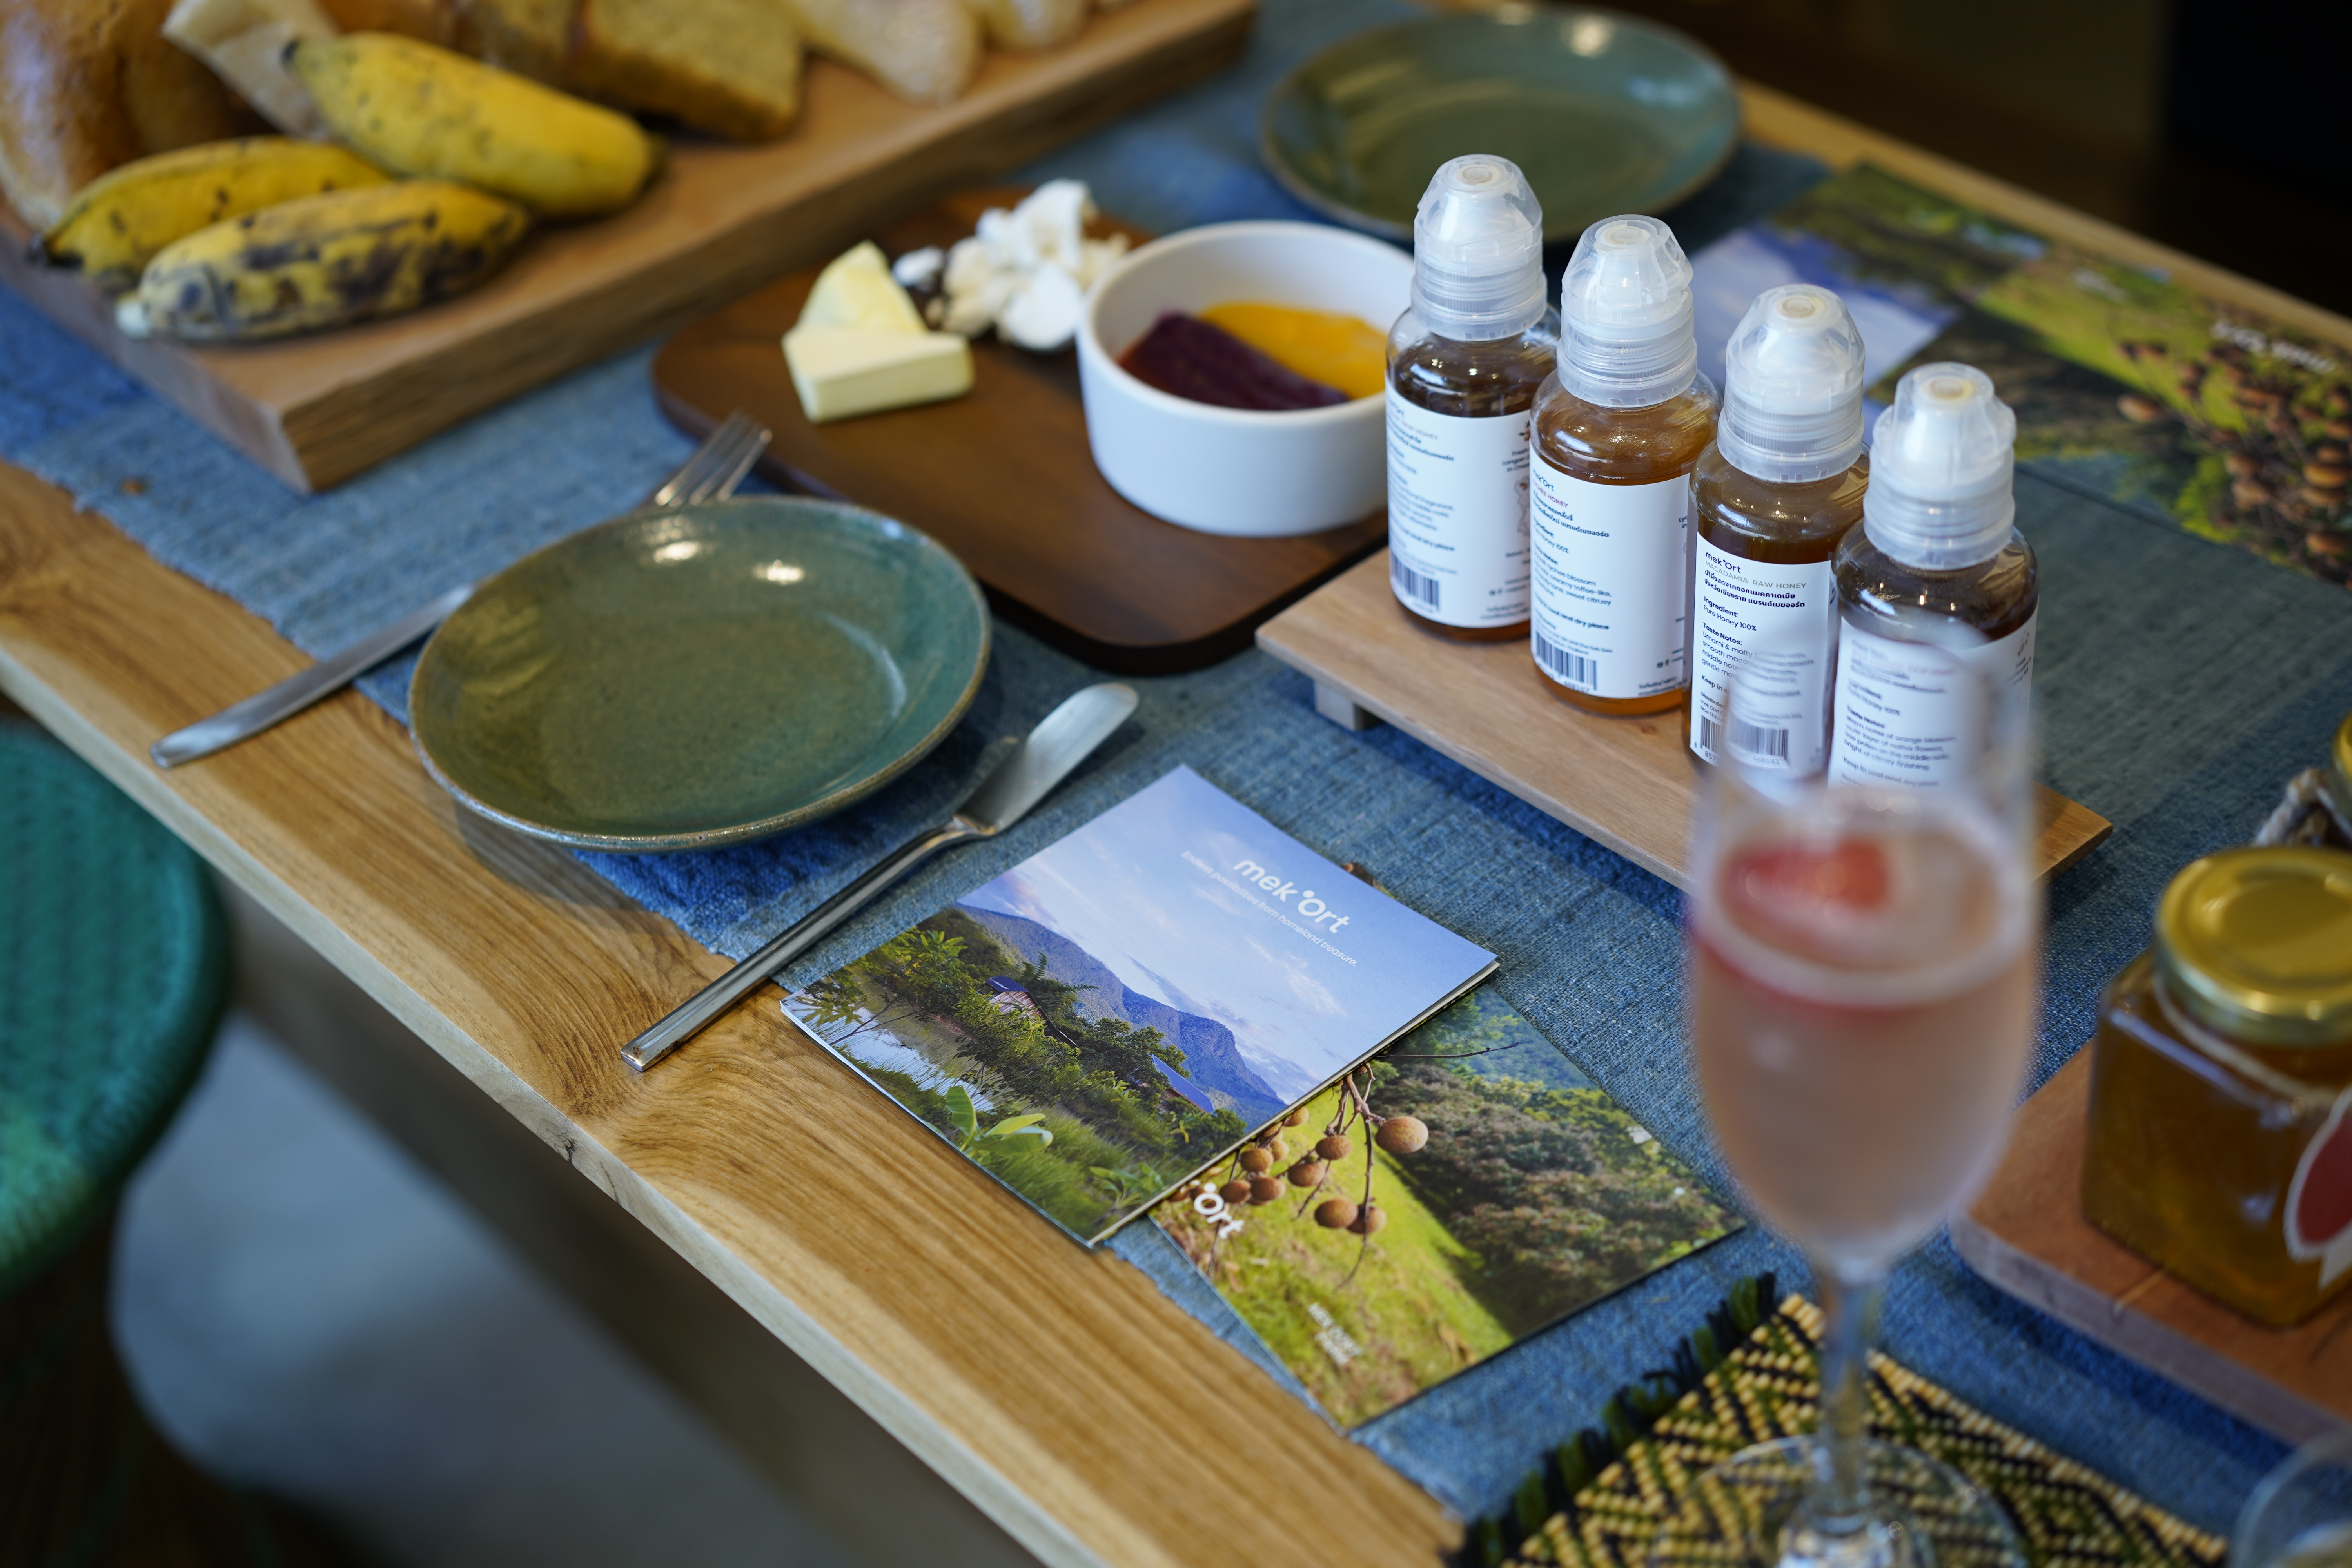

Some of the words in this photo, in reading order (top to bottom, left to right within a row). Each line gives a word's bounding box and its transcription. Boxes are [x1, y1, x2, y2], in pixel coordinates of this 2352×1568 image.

[1547, 494, 1568, 508] HONEY
[1556, 543, 1569, 554] 100%
[1548, 564, 1566, 577] lychee
[1567, 573, 1596, 586] blossom
[1705, 560, 1748, 584] MACADAMIA
[1753, 579, 1773, 588] RAW
[1550, 575, 1572, 590] creamy
[1565, 590, 1585, 601] sweet
[1586, 597, 1611, 606] citrusy
[1560, 613, 1573, 622] and
[1574, 619, 1586, 628] dry
[1704, 605, 1716, 617] Pure
[1717, 613, 1739, 628] Honey
[1740, 622, 1757, 632] 100%
[1703, 622, 1719, 636] Taste
[1720, 633, 1742, 646] Notes:
[1702, 641, 1725, 657] smooth
[1703, 631, 1724, 648] Umami
[1731, 647, 1753, 659] malty
[1702, 649, 1722, 664] middle
[1702, 658, 1720, 672] gentle
[1702, 674, 1716, 688] Keep
[1844, 738, 1862, 753] bright
[1843, 756, 1859, 770] Keep
[1885, 774, 1902, 783] and
[1209, 872, 1259, 905] possibilities
[1257, 902, 1279, 918] from
[1278, 915, 1324, 944] homeland
[1320, 942, 1357, 966] treasure.
